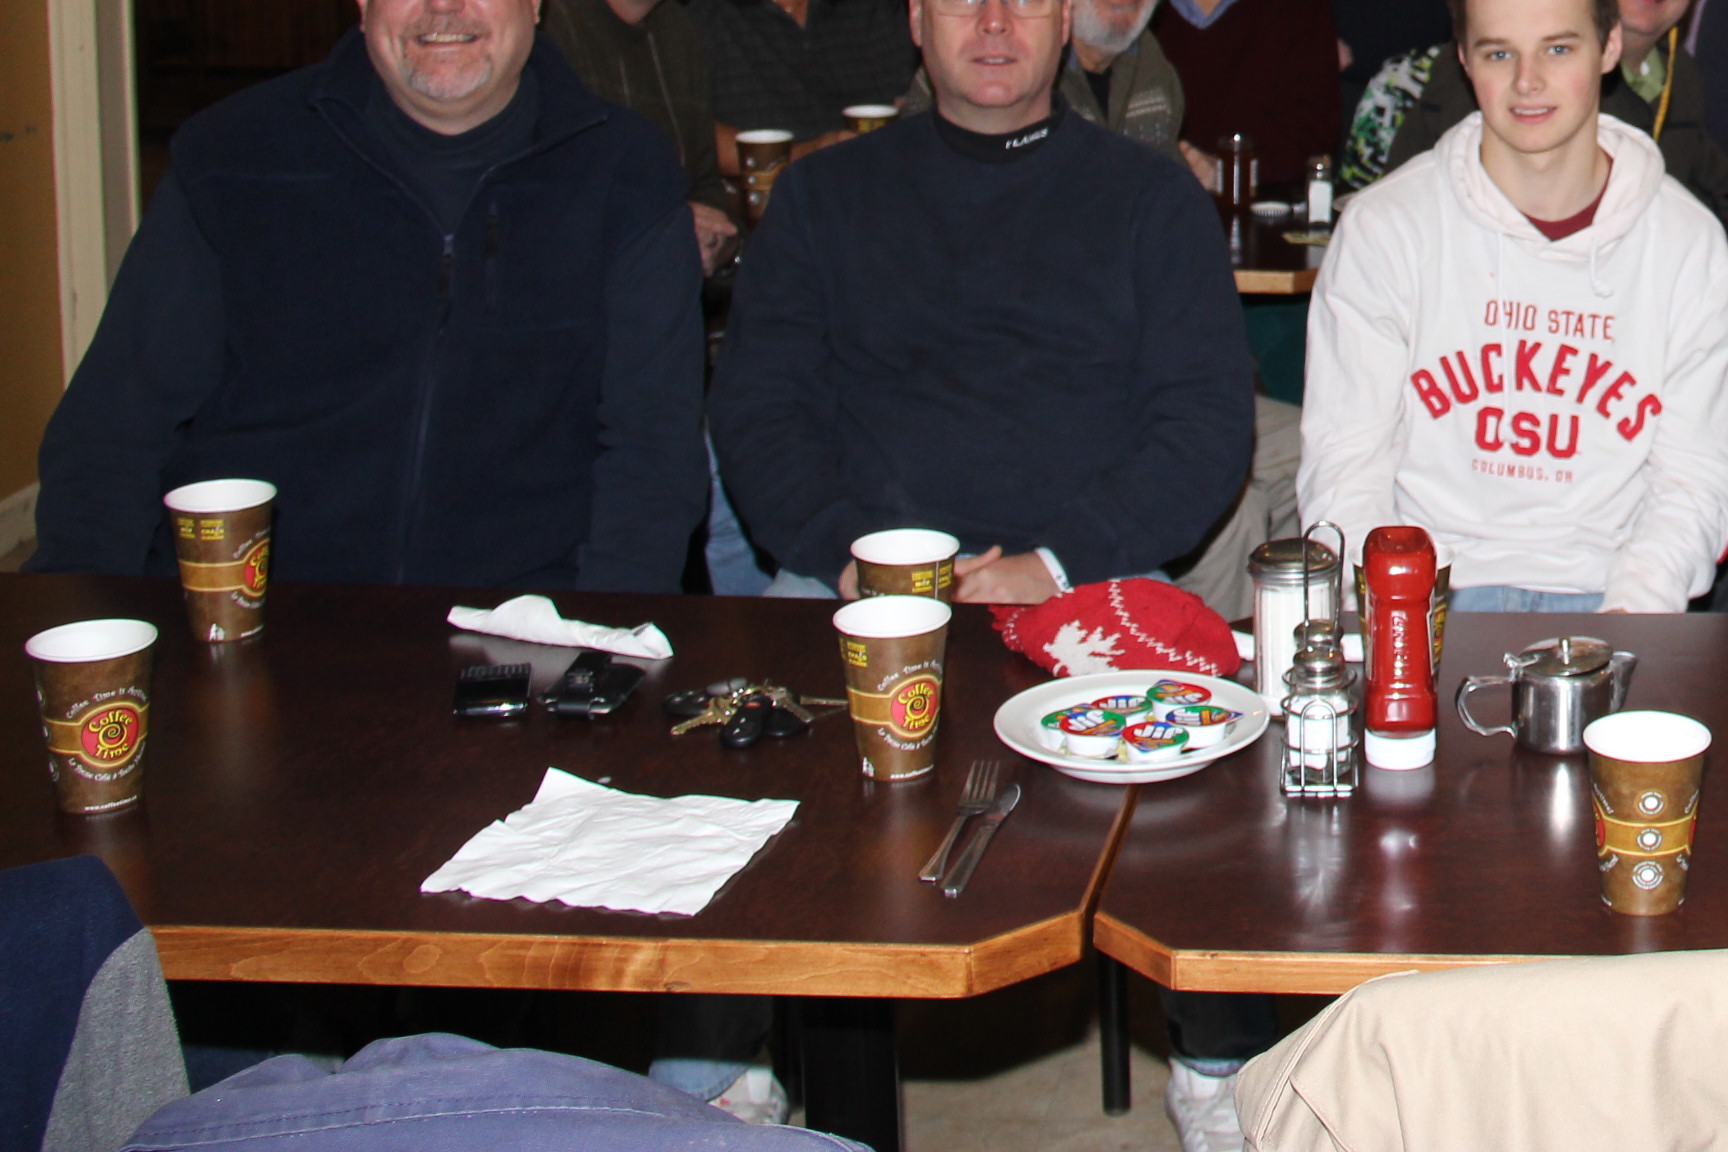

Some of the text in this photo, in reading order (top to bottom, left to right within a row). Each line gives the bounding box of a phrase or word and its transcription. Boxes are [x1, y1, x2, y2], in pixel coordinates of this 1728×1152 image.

[1484, 299, 1616, 340] OHIO STATE
[1410, 339, 1662, 442] BUCKEYES
[1474, 406, 1579, 459] OSU
[898, 682, 934, 704] Coffee
[88, 709, 133, 733] Coffee
[904, 713, 932, 731] Time
[95, 743, 130, 760] Time
